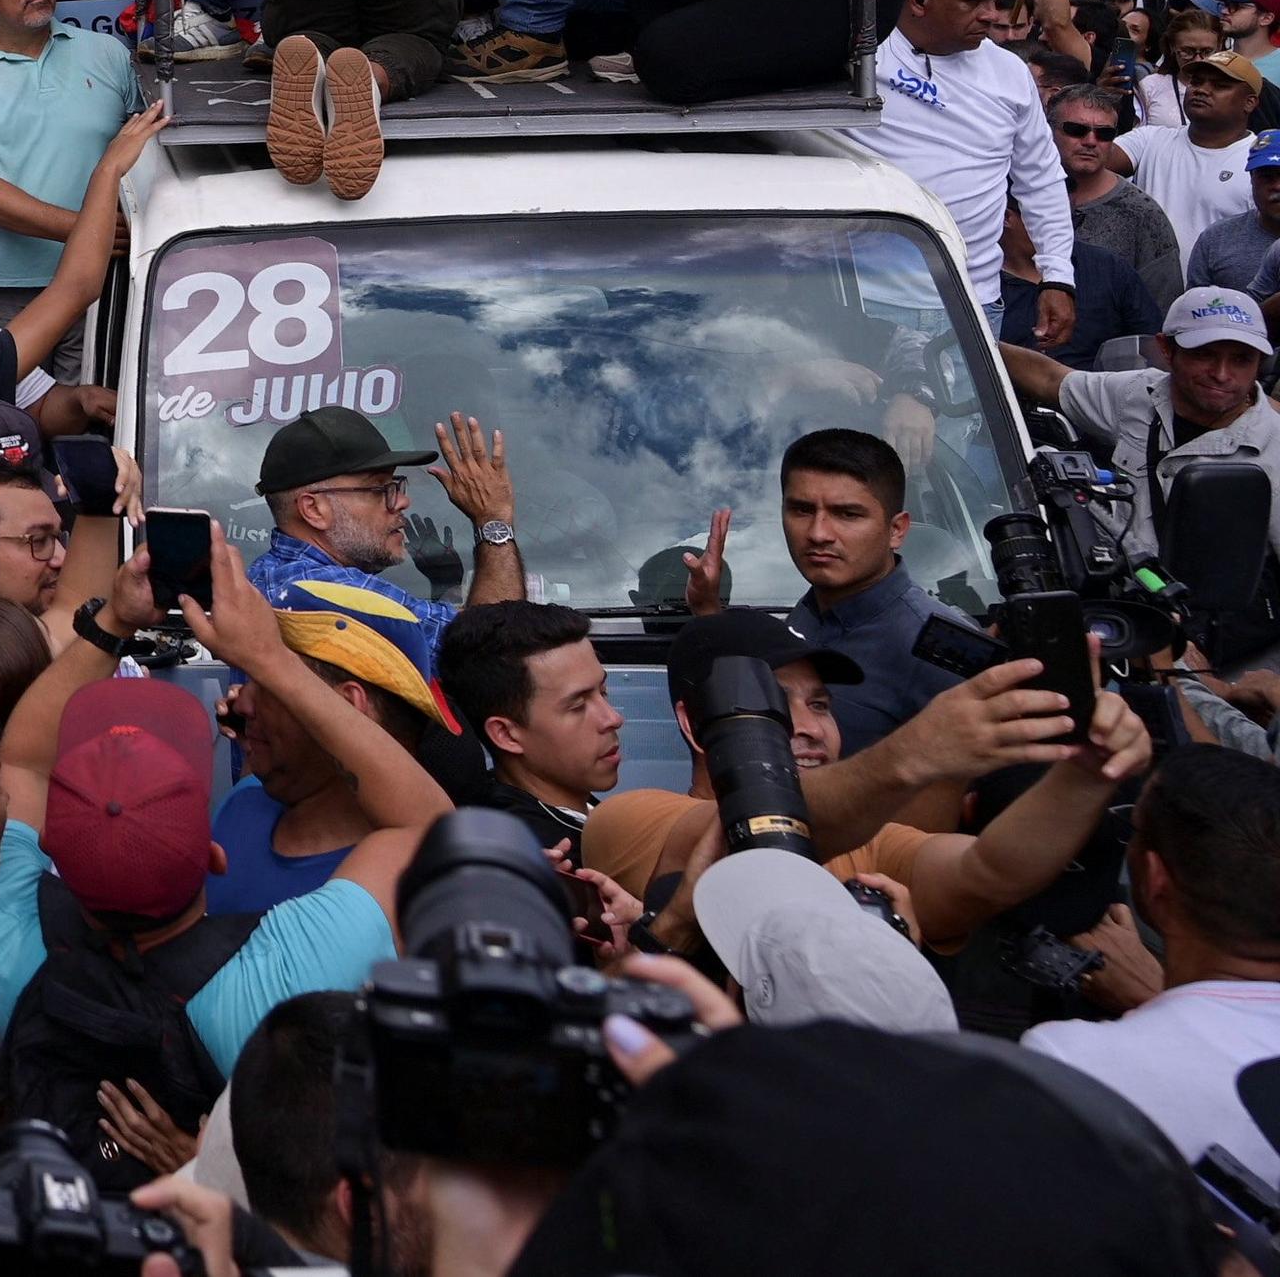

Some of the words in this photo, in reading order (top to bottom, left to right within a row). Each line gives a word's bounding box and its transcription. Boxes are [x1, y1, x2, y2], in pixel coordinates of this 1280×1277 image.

[162, 262, 334, 376] 28
[1191, 305, 1240, 320] NESTEA
[157, 386, 216, 422] de
